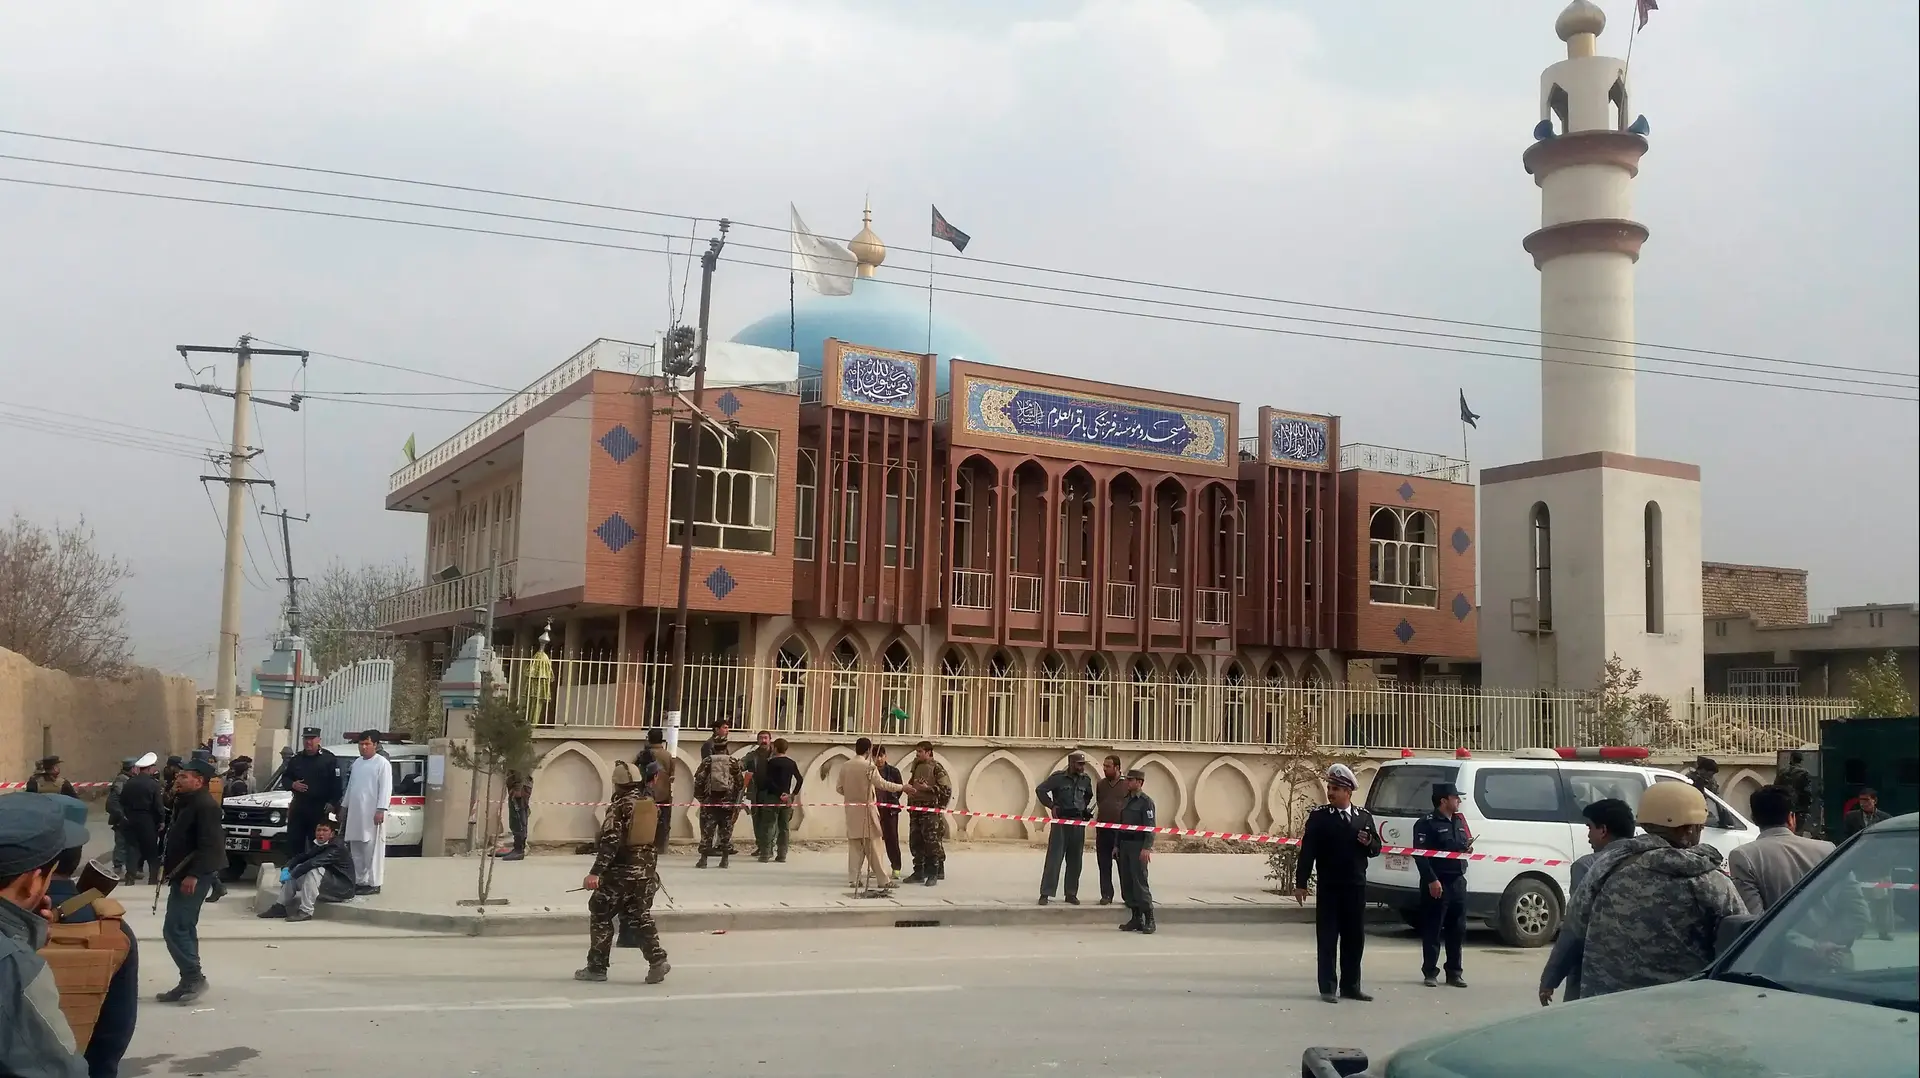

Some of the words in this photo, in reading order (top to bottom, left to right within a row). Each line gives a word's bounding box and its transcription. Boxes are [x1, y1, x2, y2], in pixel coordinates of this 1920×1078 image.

[1087, 410, 1117, 440] فرهنگی
[1142, 419, 1187, 446] مسجد
[400, 796, 407, 805] 6
